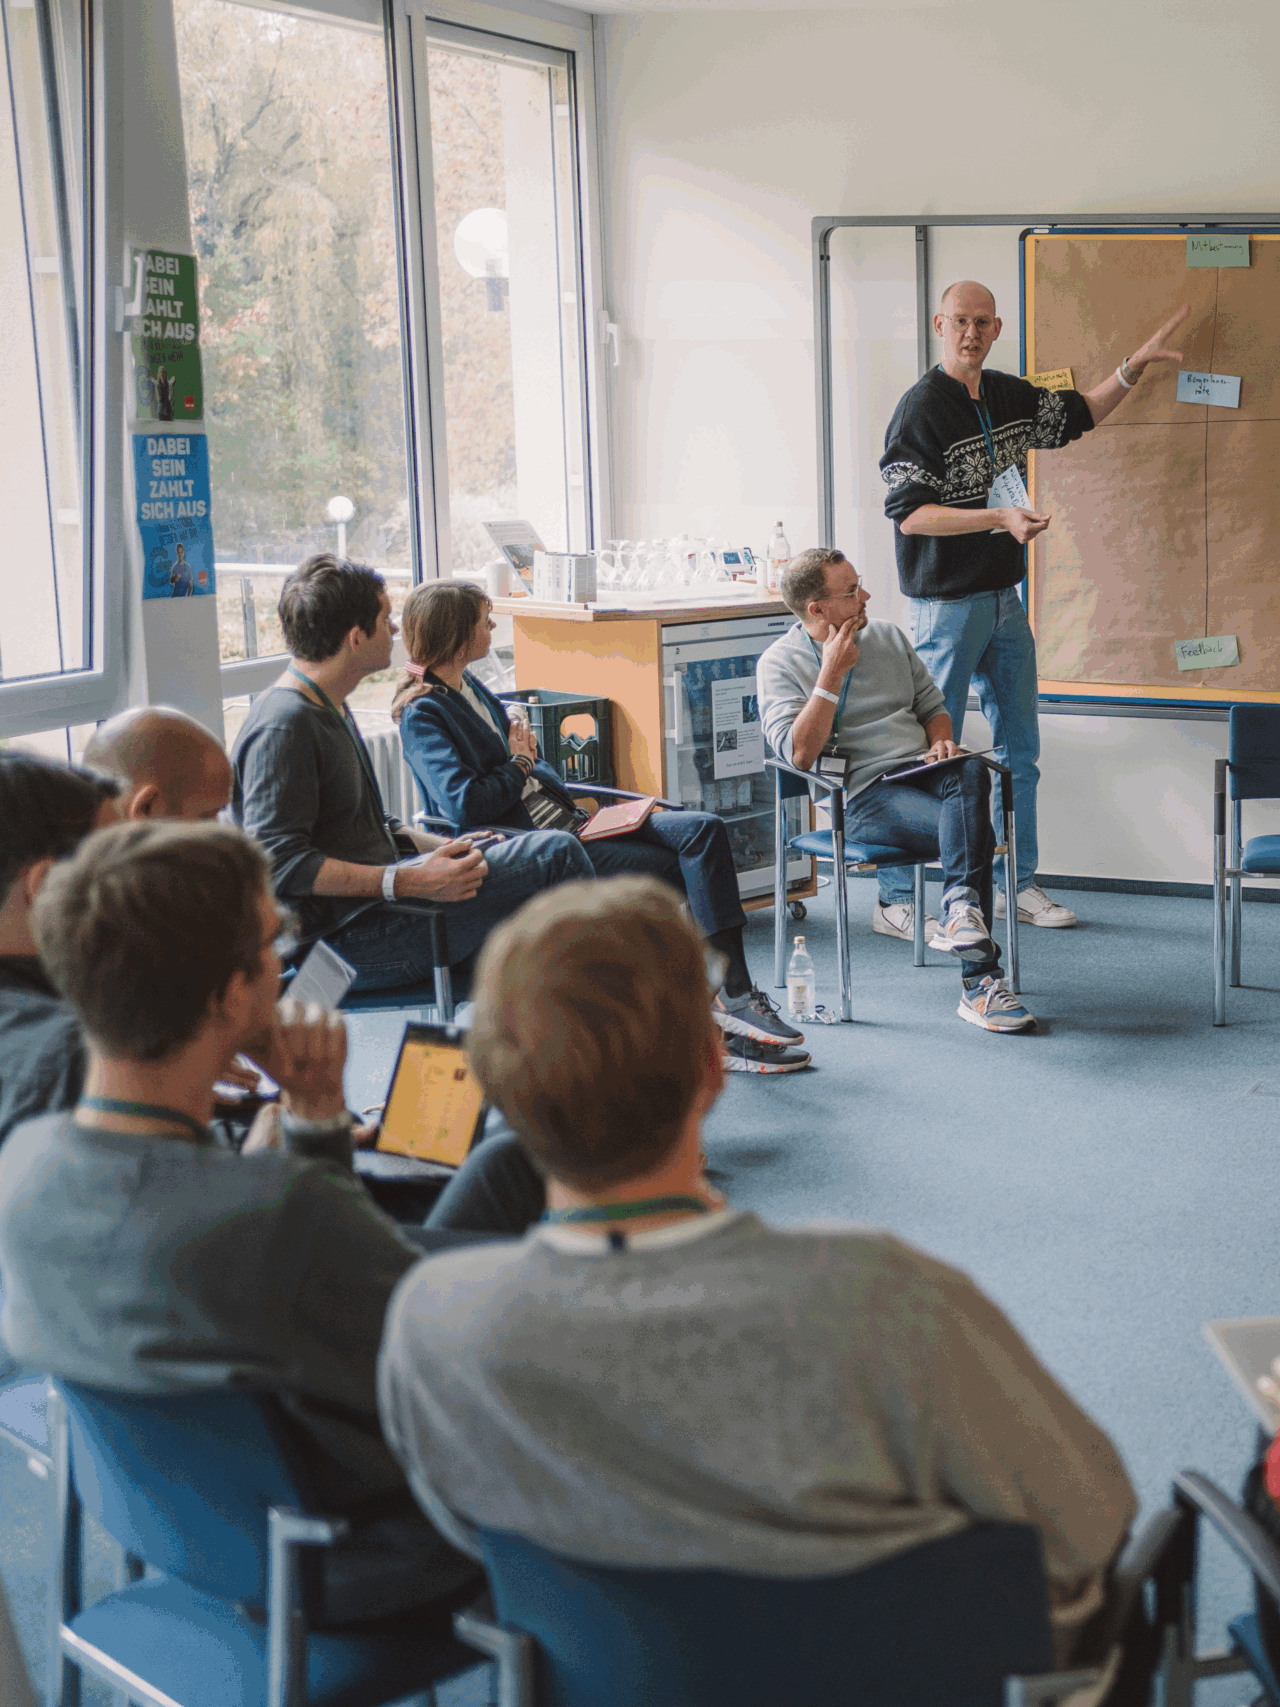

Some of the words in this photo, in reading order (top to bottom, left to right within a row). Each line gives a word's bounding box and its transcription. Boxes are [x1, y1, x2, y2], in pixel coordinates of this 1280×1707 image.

[144, 254, 180, 276] ABEI
[145, 298, 184, 319] AHLT
[163, 321, 196, 341] AUS
[147, 437, 191, 456] DABEI
[152, 459, 185, 477] SEIN
[149, 479, 194, 499] ZAHLT
[141, 502, 174, 520] SICH
[176, 500, 207, 518] AUS
[1180, 640, 1222, 659] Feedback
